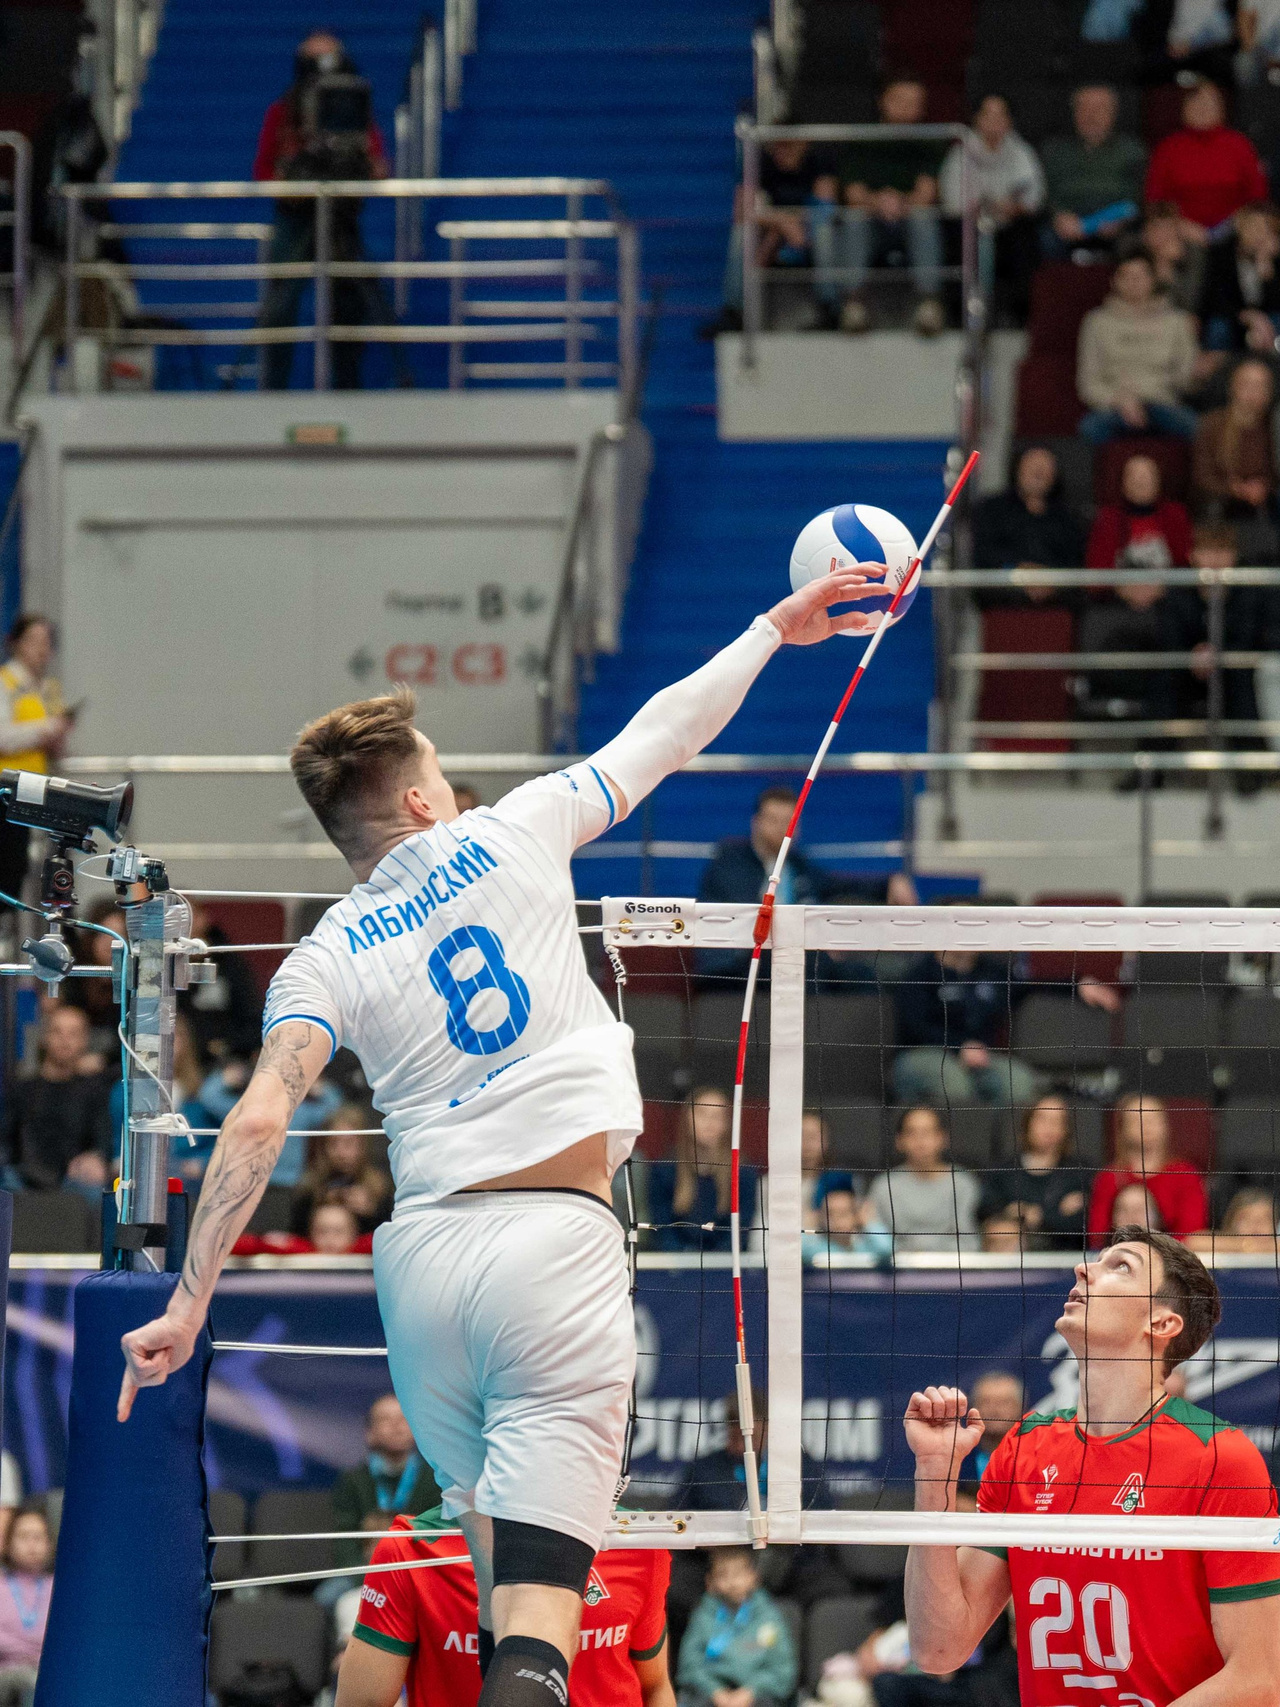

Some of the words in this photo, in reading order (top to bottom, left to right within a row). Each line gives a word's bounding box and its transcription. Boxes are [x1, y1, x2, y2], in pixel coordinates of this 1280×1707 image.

[343, 834, 499, 954] ЛАБИНСКИЙ
[637, 903, 681, 914] Senoh
[427, 925, 531, 1056] 8
[1028, 1576, 1134, 1673] 20
